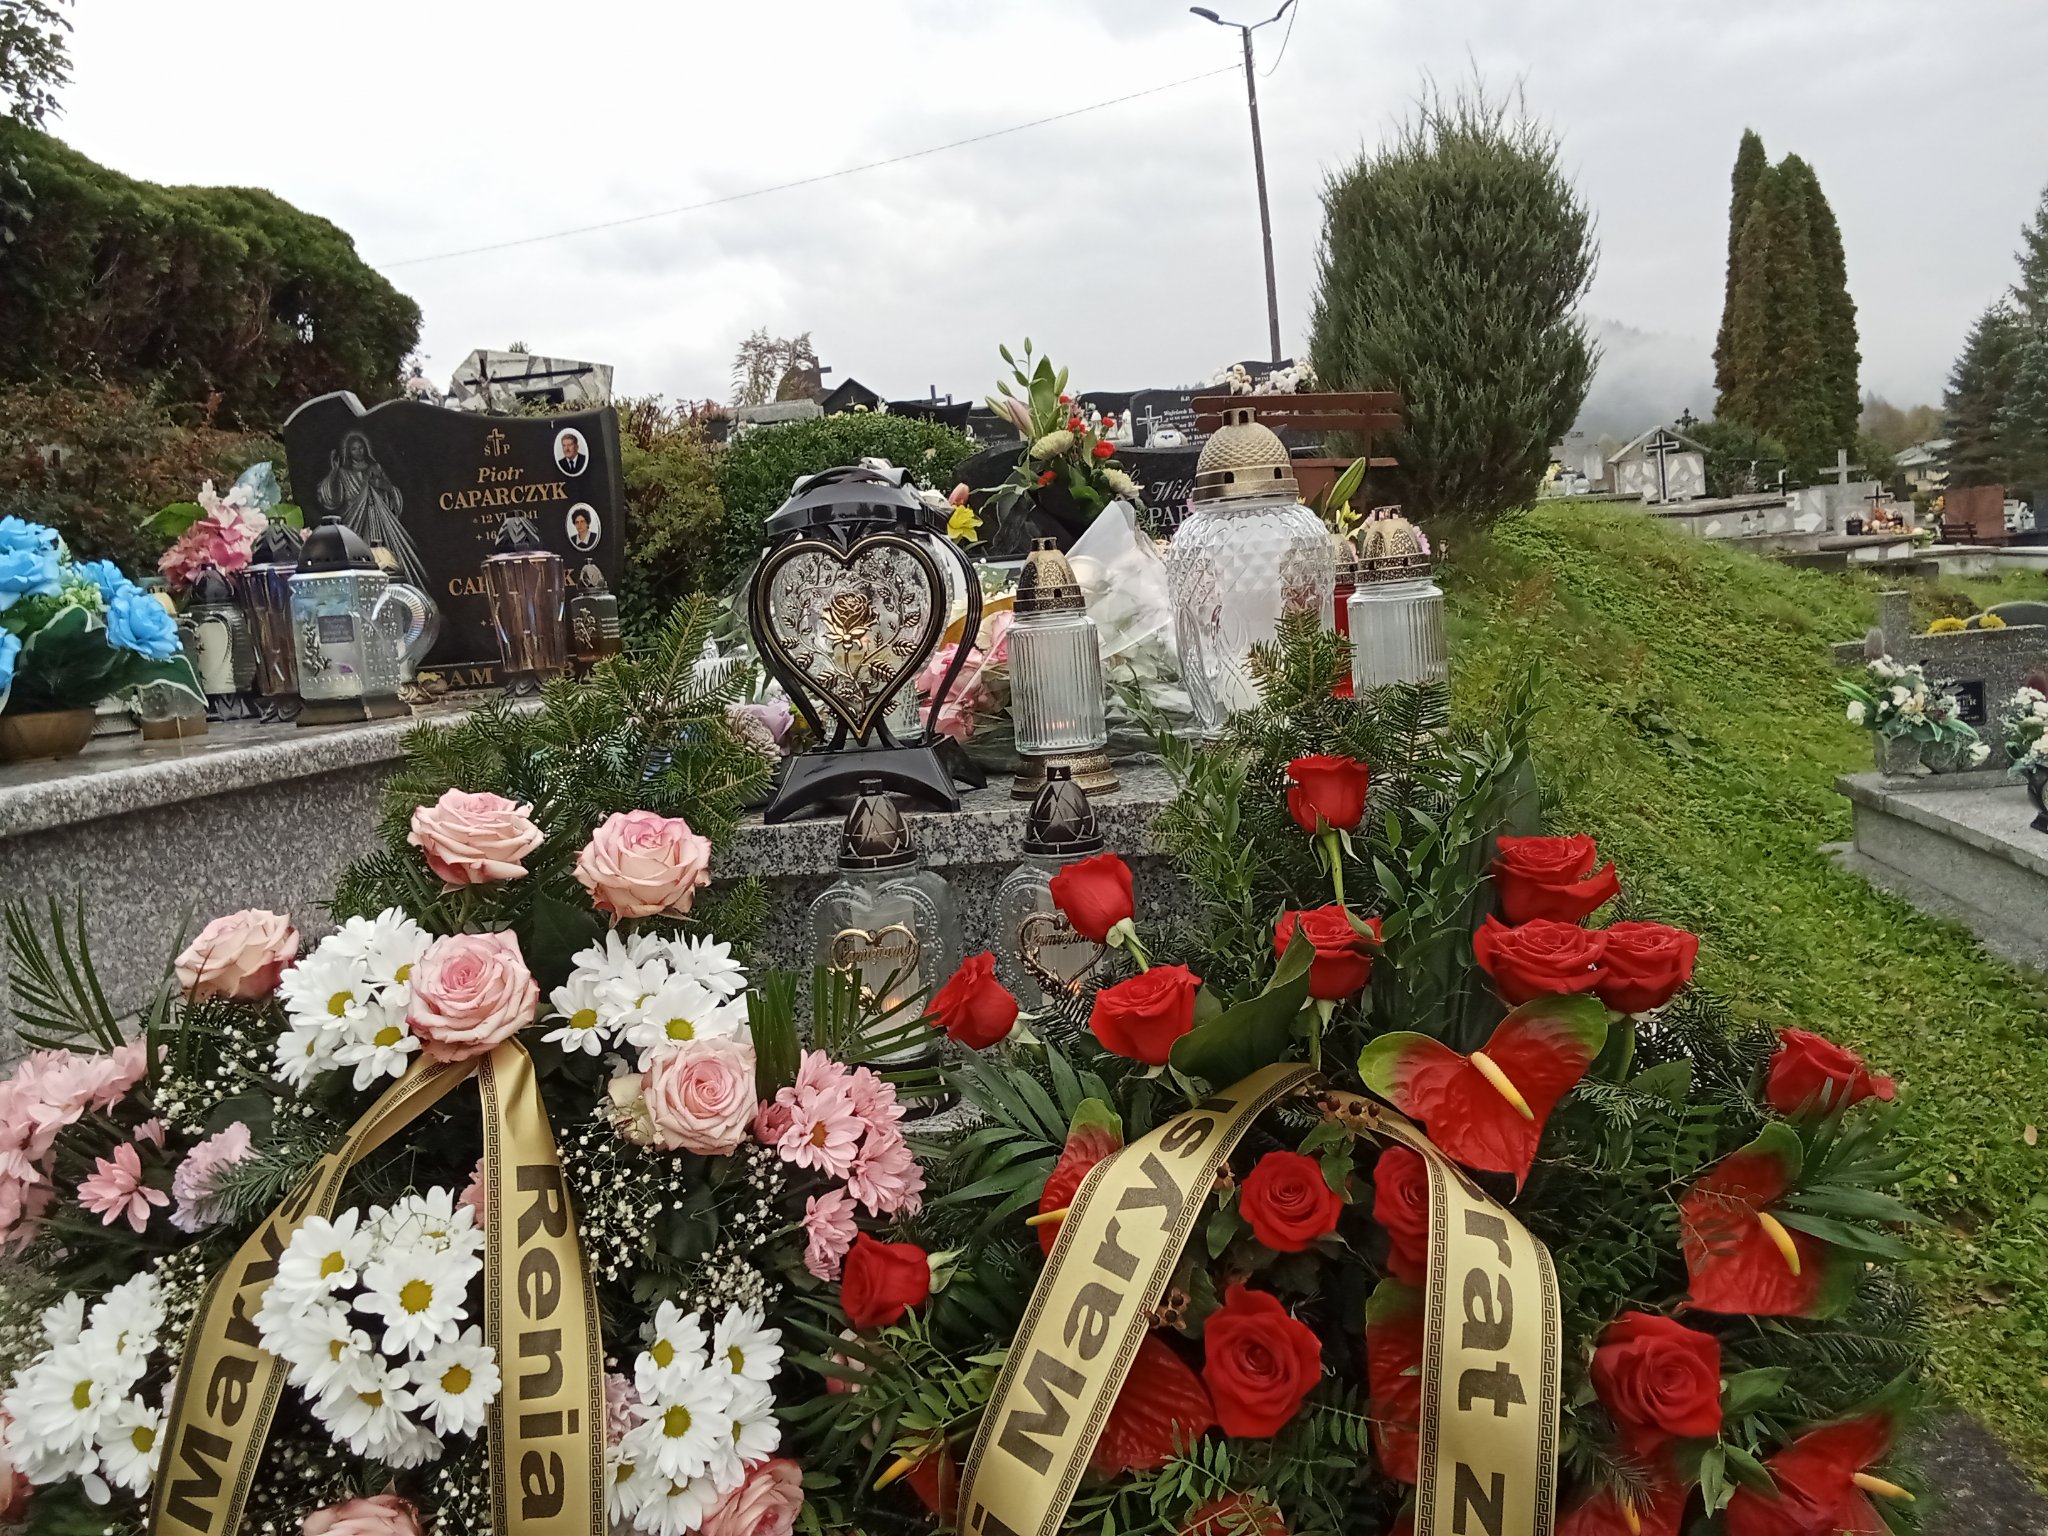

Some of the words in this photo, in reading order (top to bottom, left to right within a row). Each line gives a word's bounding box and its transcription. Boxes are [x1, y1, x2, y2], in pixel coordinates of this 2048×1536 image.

[477, 466, 524, 483] Piotr
[439, 482, 569, 511] CAPARCZYK
[1151, 478, 1194, 502] Wik
[441, 667, 495, 686] AM
[516, 1163, 581, 1523] Renia
